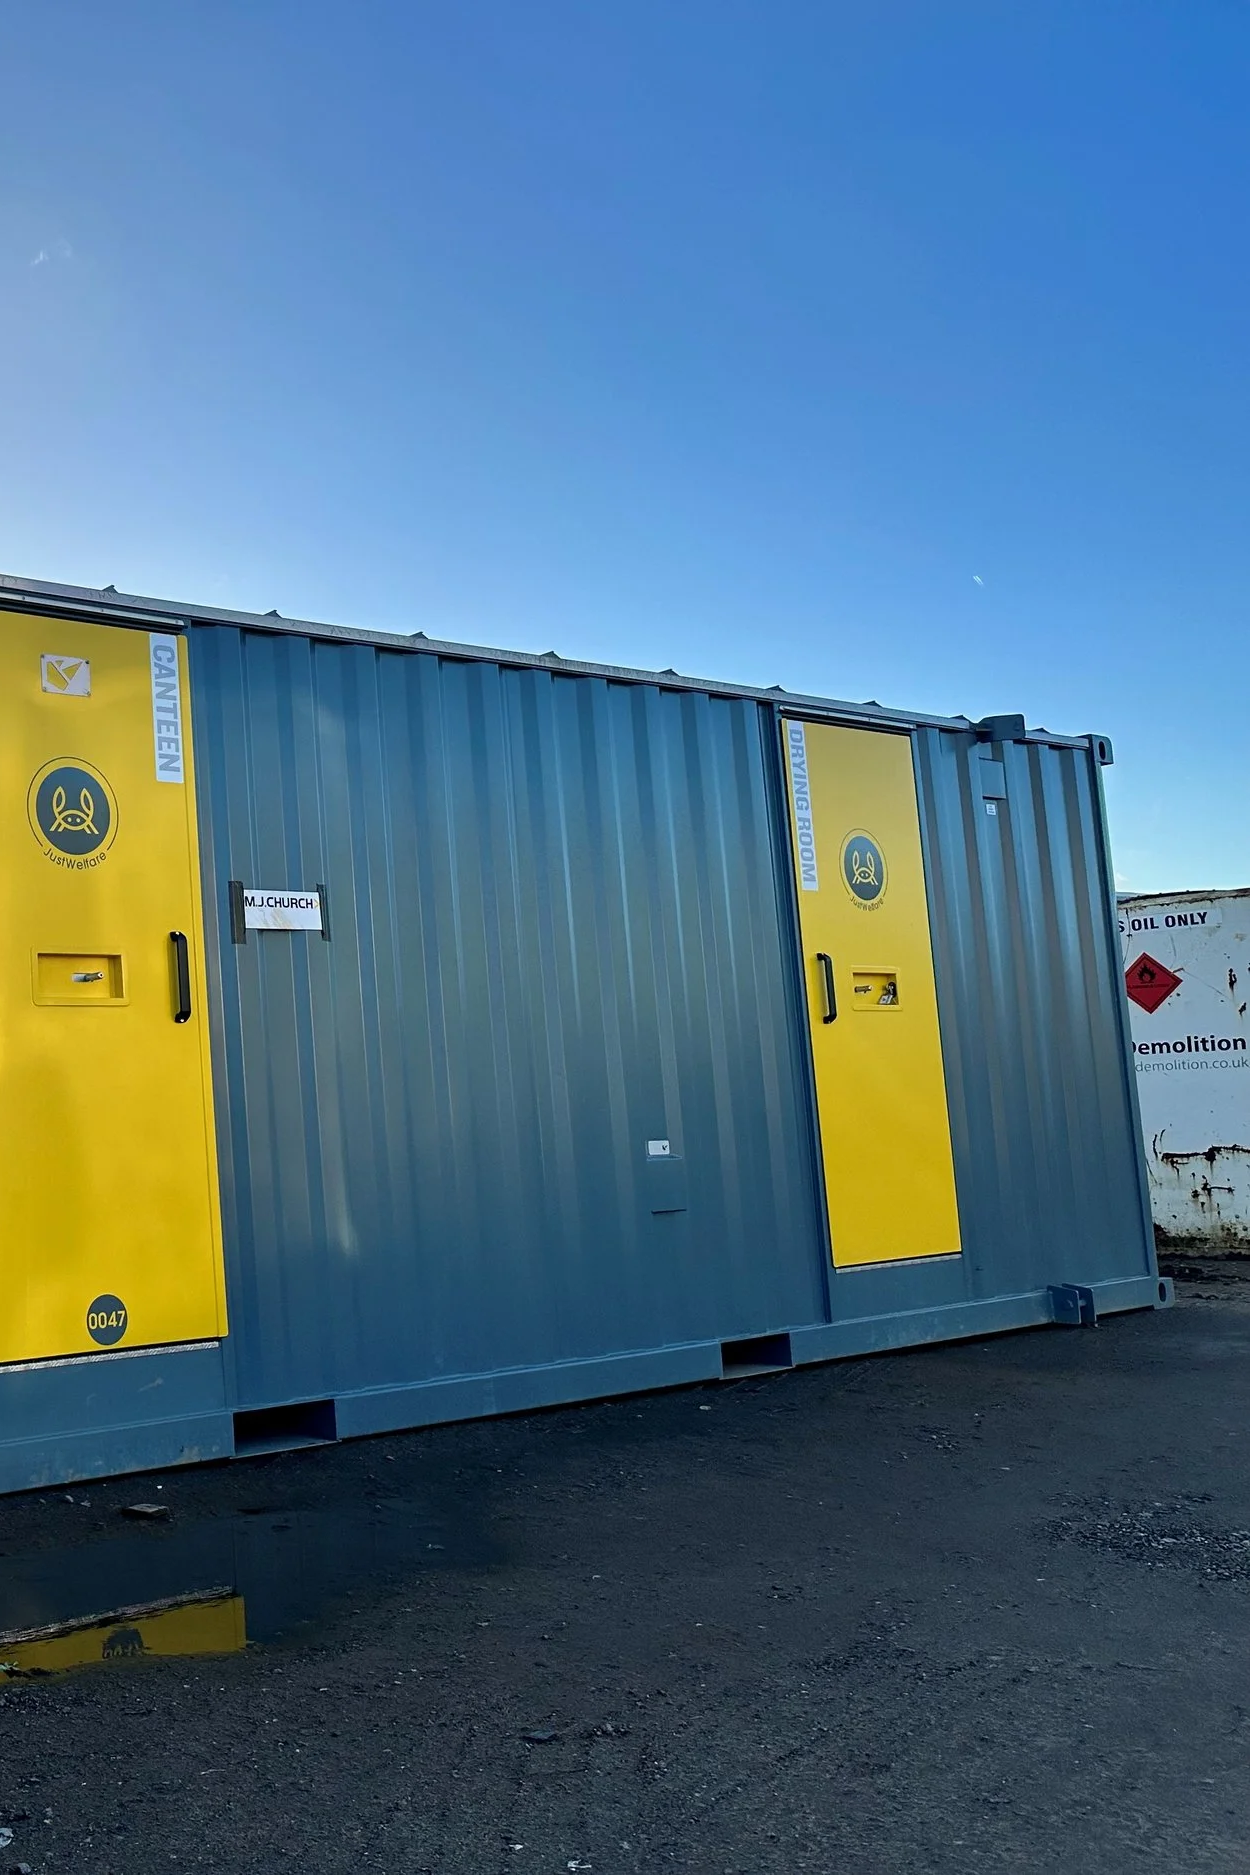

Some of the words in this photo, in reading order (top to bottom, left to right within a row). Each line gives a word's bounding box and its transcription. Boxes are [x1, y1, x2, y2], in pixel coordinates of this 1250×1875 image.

[152, 644, 181, 772] CANTEEN
[789, 728, 810, 811] DRYING
[43, 848, 107, 870] JustWelfare
[797, 816, 817, 882] ROOM
[1131, 918, 1159, 931] OIL
[1165, 912, 1207, 928] ONLY
[88, 1310, 126, 1330] 0047
